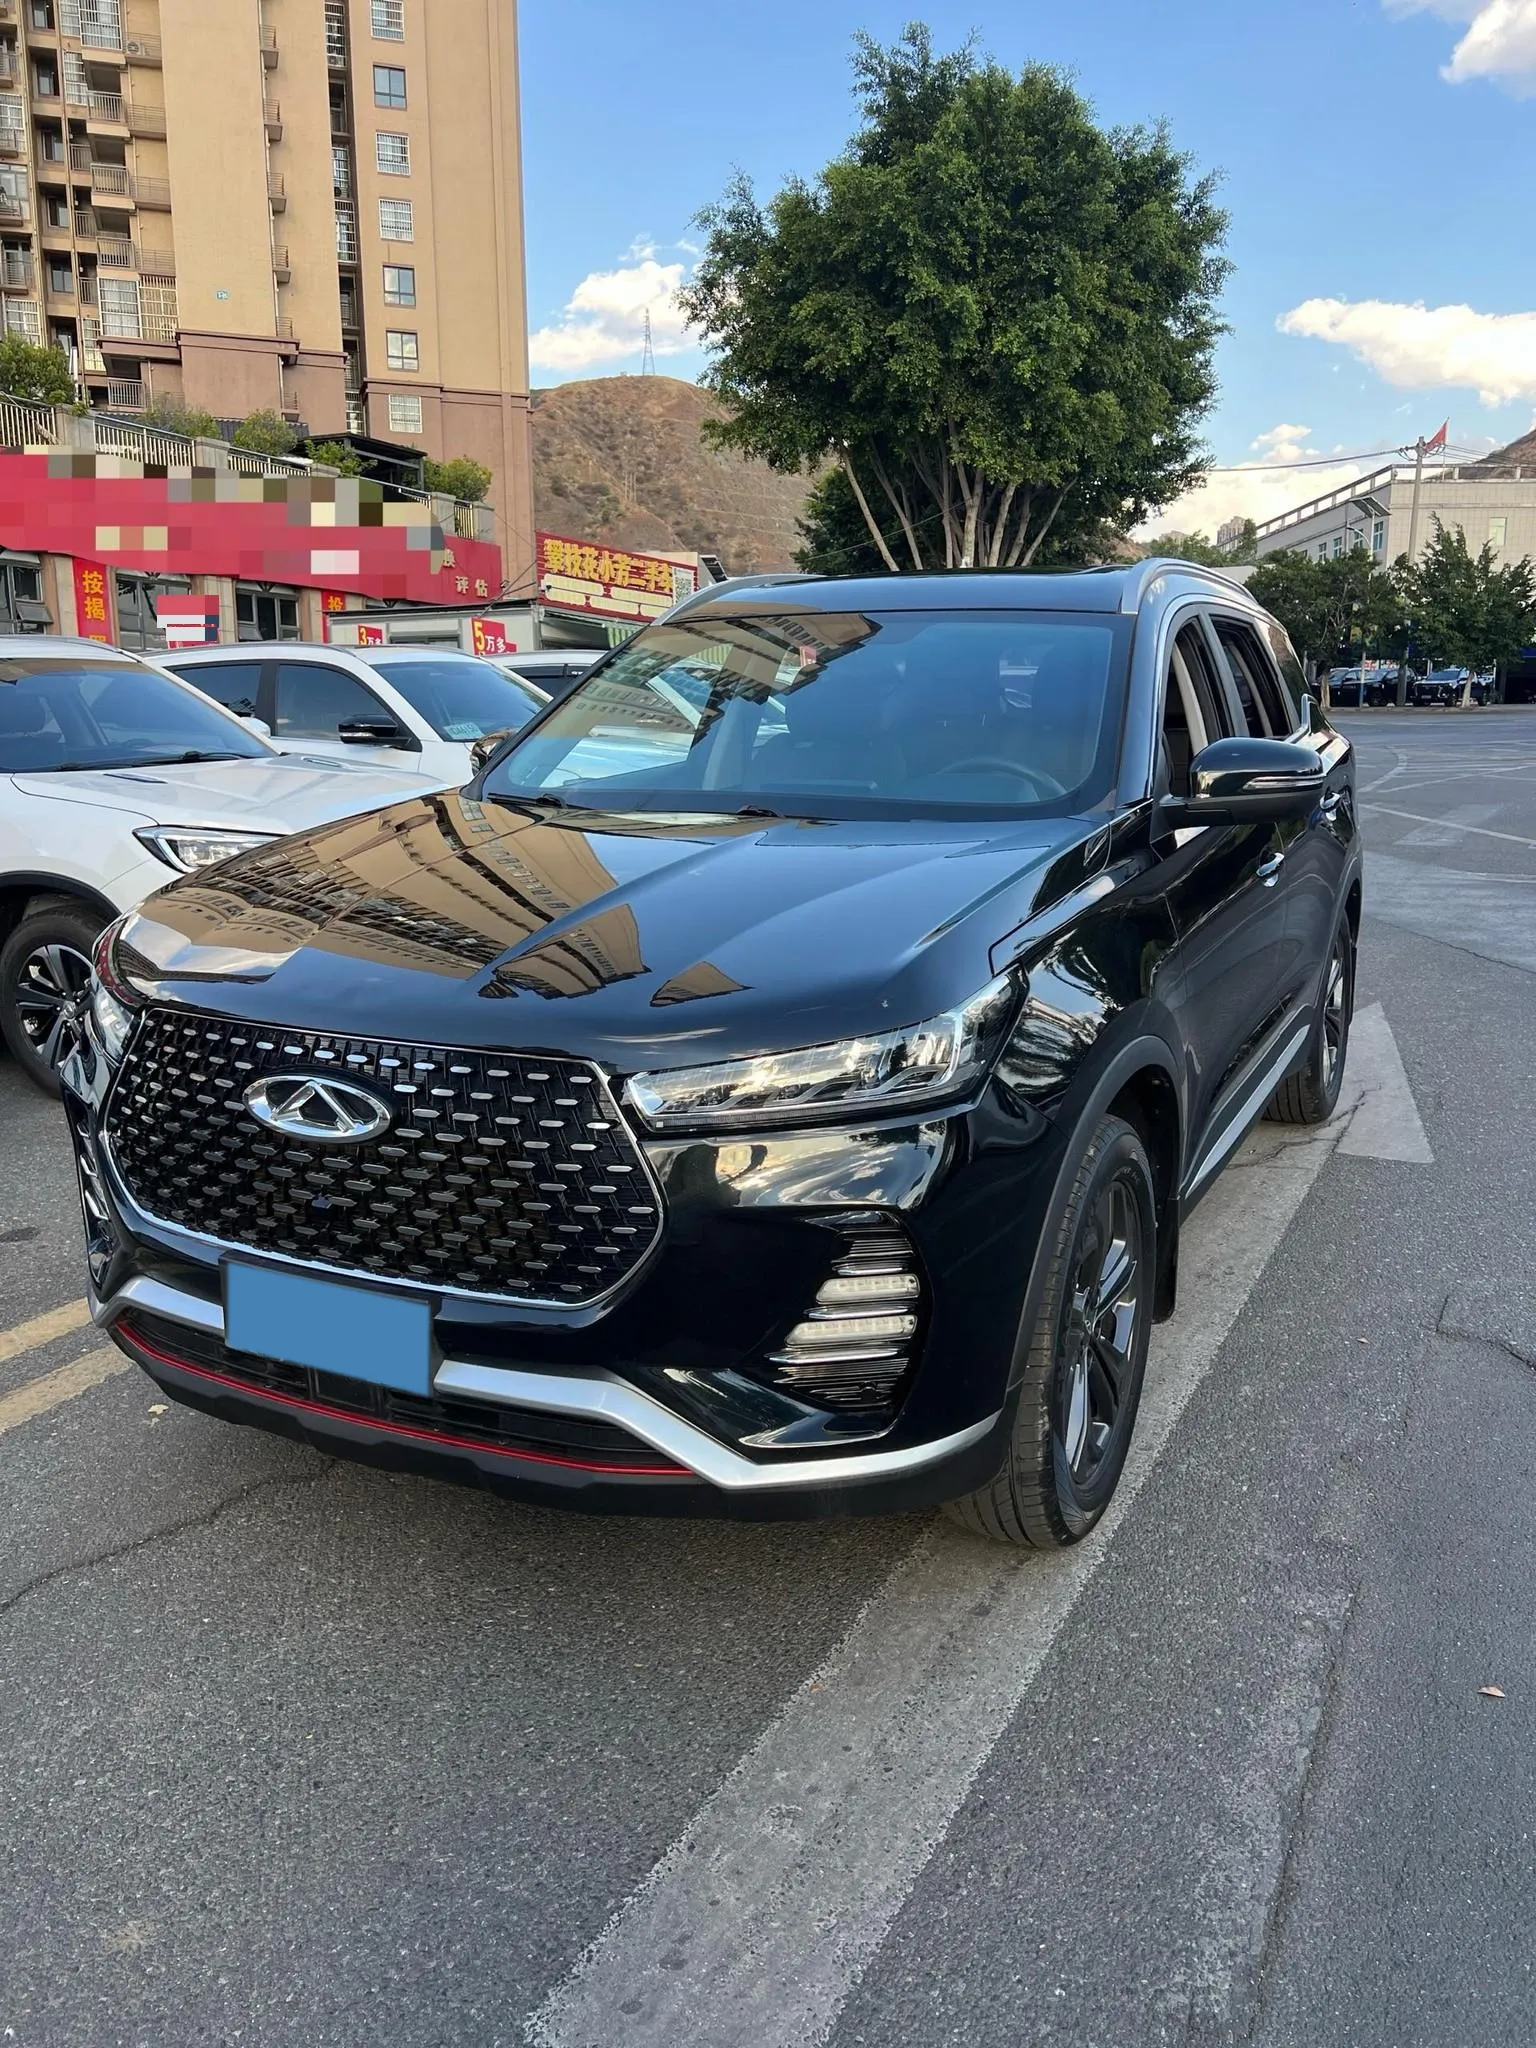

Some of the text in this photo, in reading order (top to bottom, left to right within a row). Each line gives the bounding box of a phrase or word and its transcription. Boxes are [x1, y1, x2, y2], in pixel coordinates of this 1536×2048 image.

[83, 571, 106, 621] 按揭
[455, 575, 488, 597] 评估
[473, 621, 506, 653] 5万多
